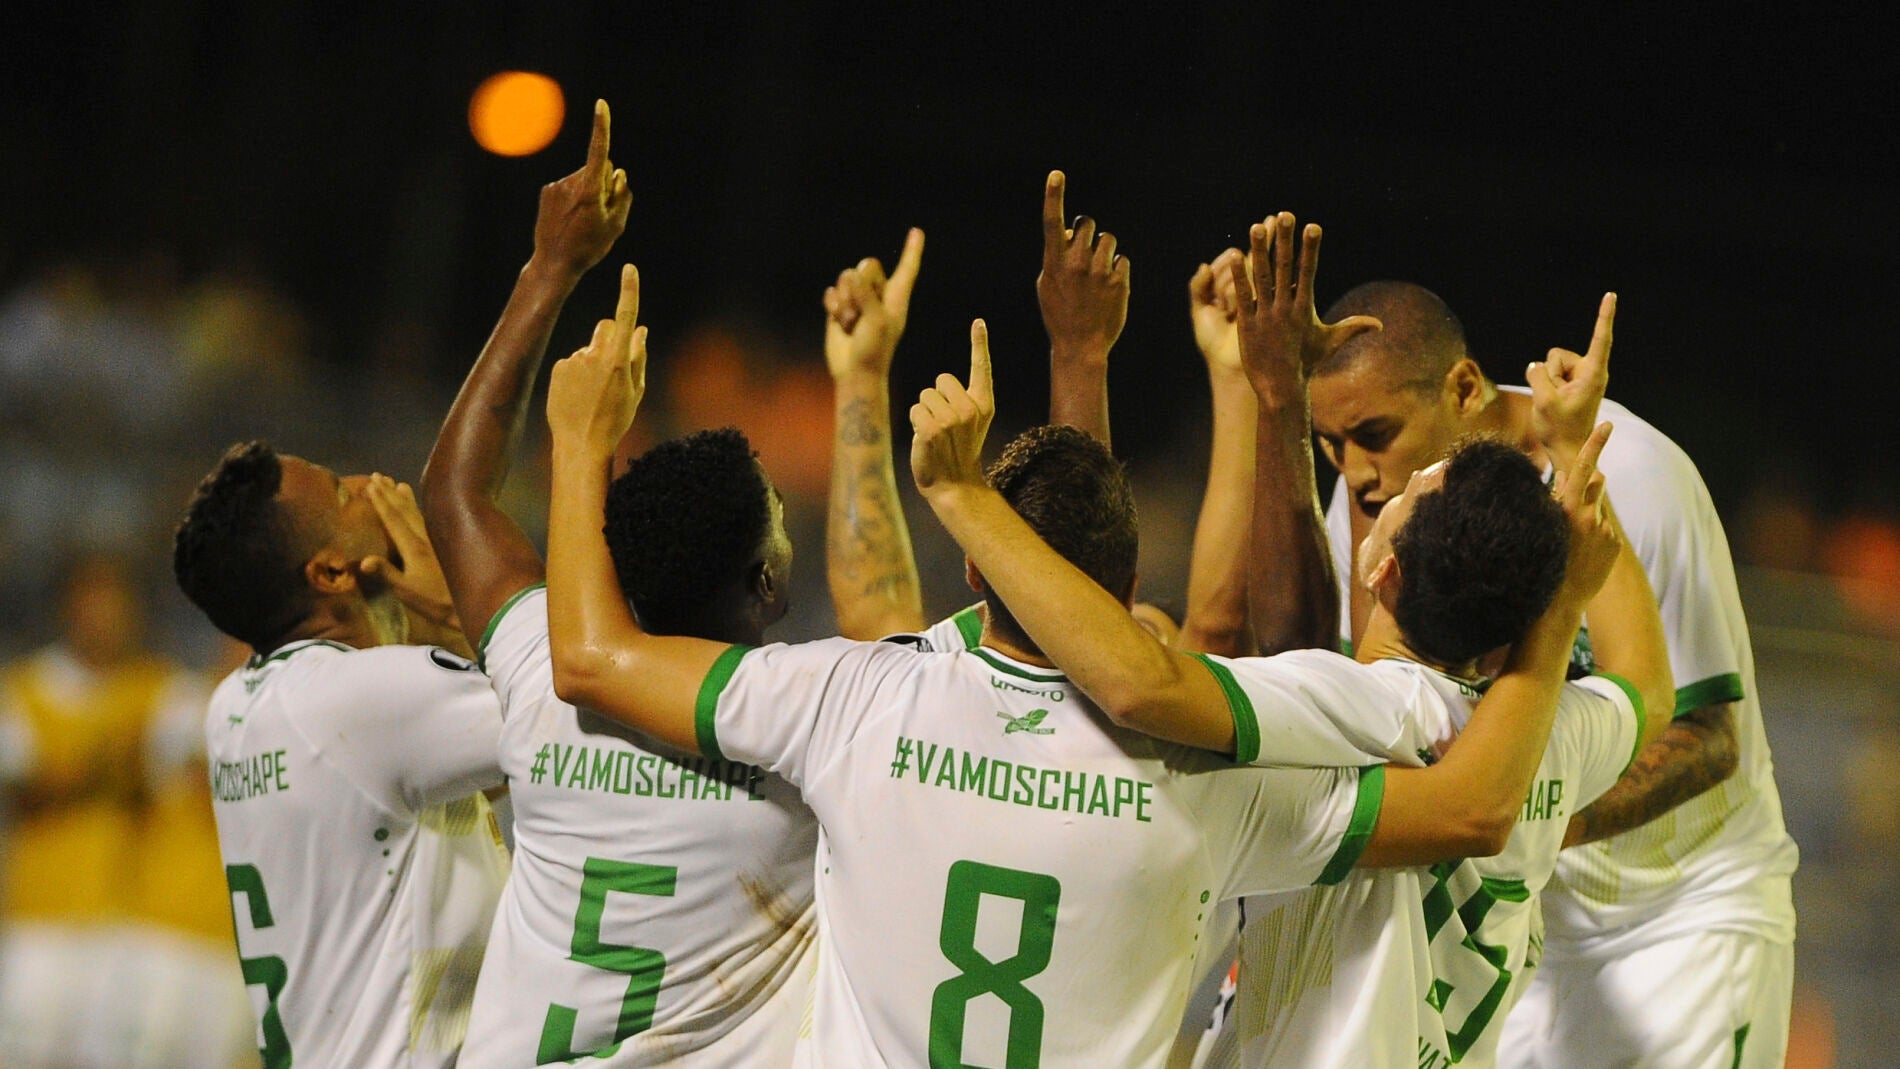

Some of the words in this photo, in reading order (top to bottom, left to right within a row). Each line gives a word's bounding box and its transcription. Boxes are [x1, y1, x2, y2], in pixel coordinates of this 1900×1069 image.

[530, 743, 766, 801] #VAMOSCHAPE
[890, 736, 1154, 823] #VAMOSCHAPE
[536, 856, 678, 1066] 5
[928, 860, 1061, 1069] 8
